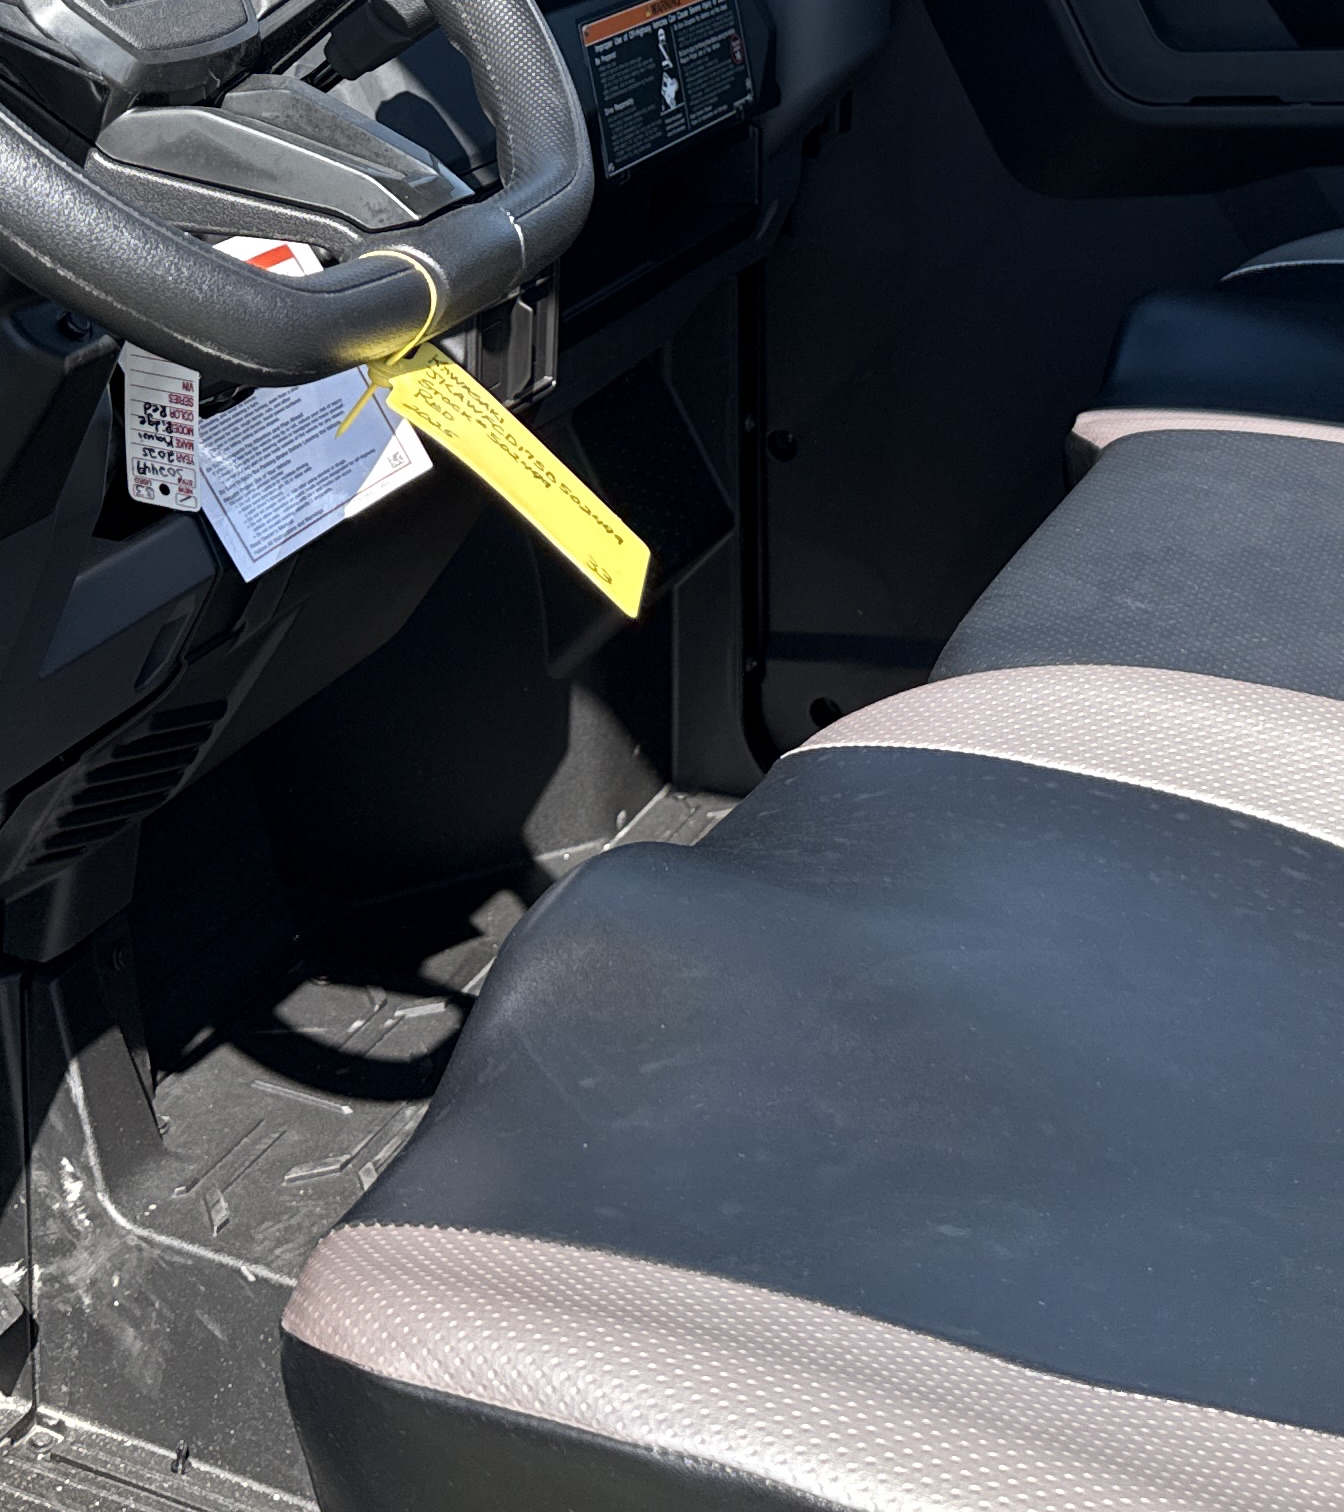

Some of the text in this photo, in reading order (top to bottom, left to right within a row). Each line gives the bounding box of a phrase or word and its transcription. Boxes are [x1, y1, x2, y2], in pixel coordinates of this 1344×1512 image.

[182, 381, 194, 393] VIN
[428, 354, 505, 424] KAWASAKI
[168, 393, 194, 408] SERIES
[143, 402, 168, 418] Red
[169, 407, 194, 423] COLOR
[171, 422, 194, 437] MODE
[175, 436, 194, 451] MAKE
[142, 447, 175, 464] 2025
[175, 450, 195, 466] YEAR
